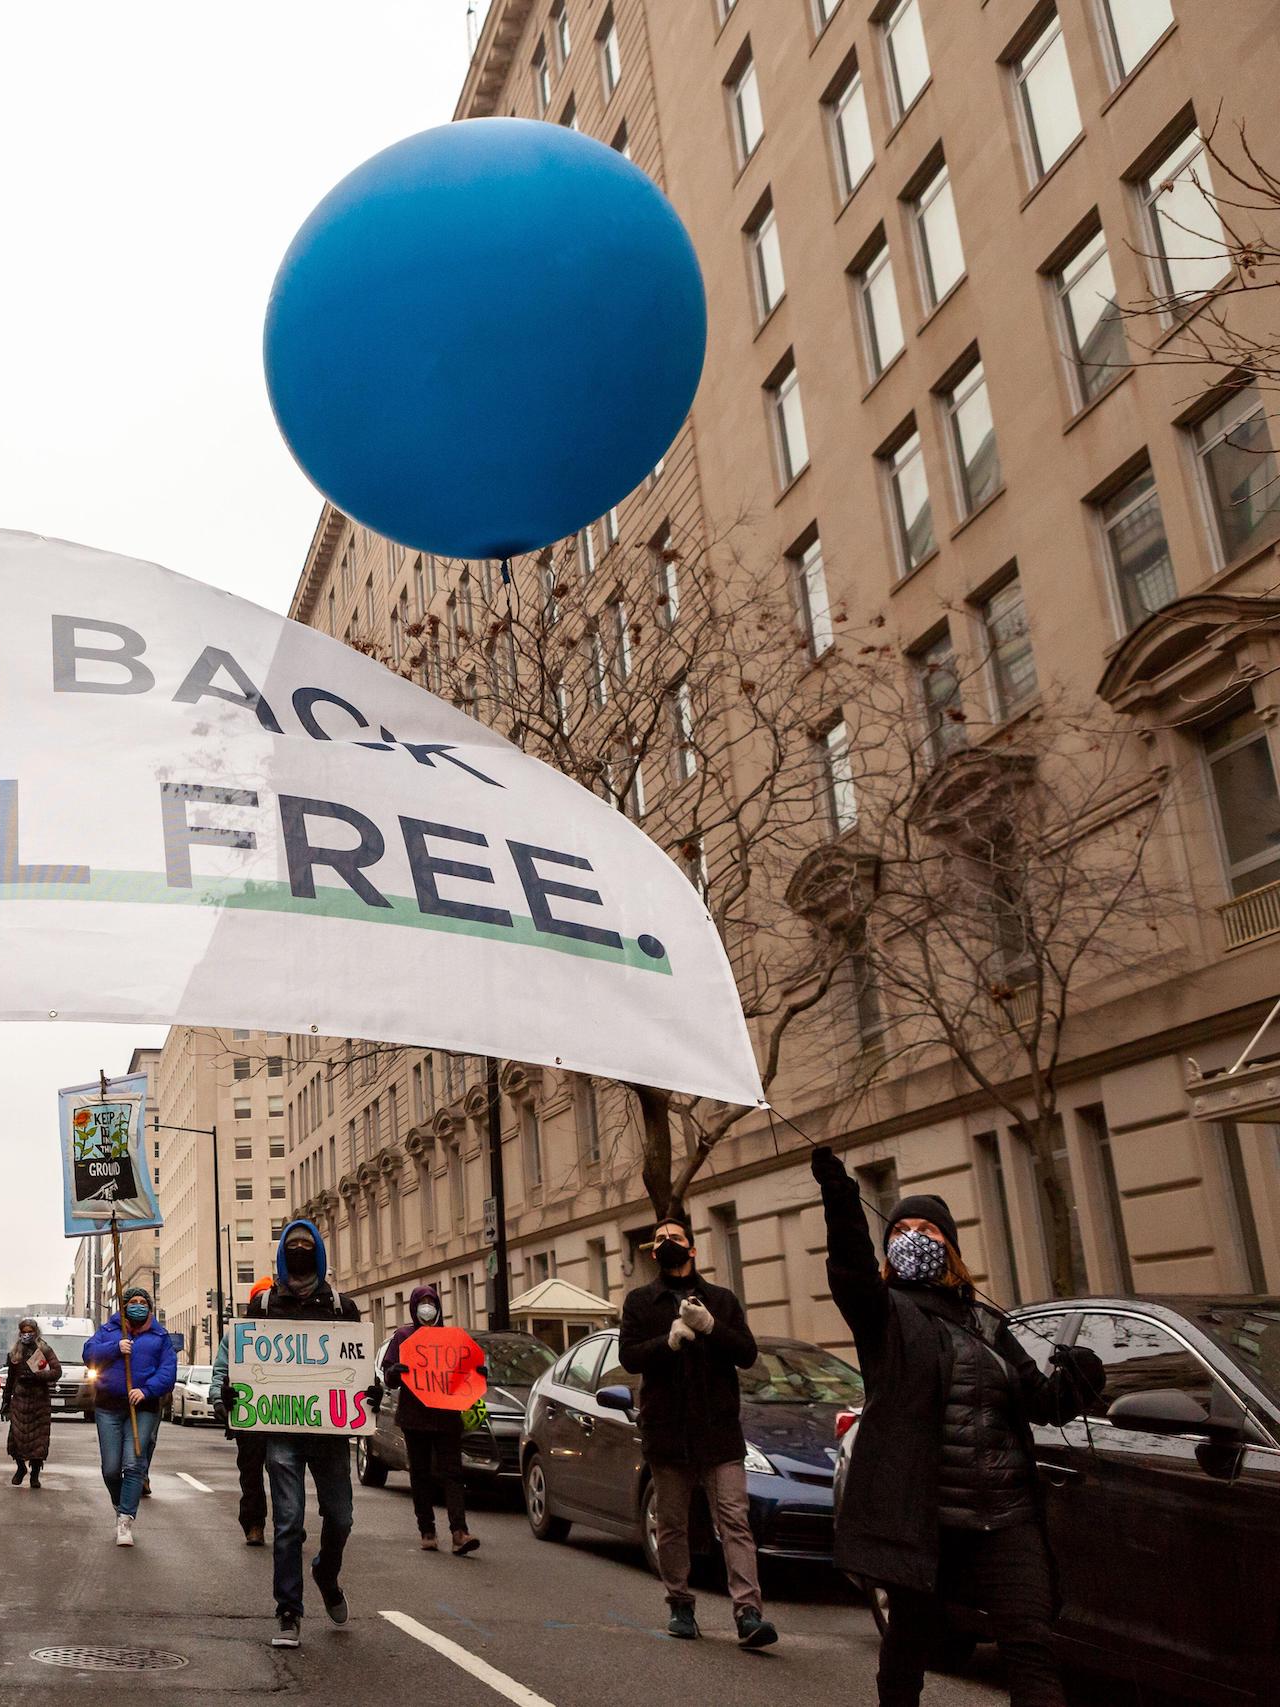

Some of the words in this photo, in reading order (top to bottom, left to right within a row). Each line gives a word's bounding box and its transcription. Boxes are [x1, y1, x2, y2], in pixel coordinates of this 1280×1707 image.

[160, 781, 665, 959] FREE.
[339, 1342, 366, 1360] ARE
[416, 1344, 471, 1370] STOP
[414, 1369, 456, 1396] LINE
[328, 1389, 368, 1429] US
